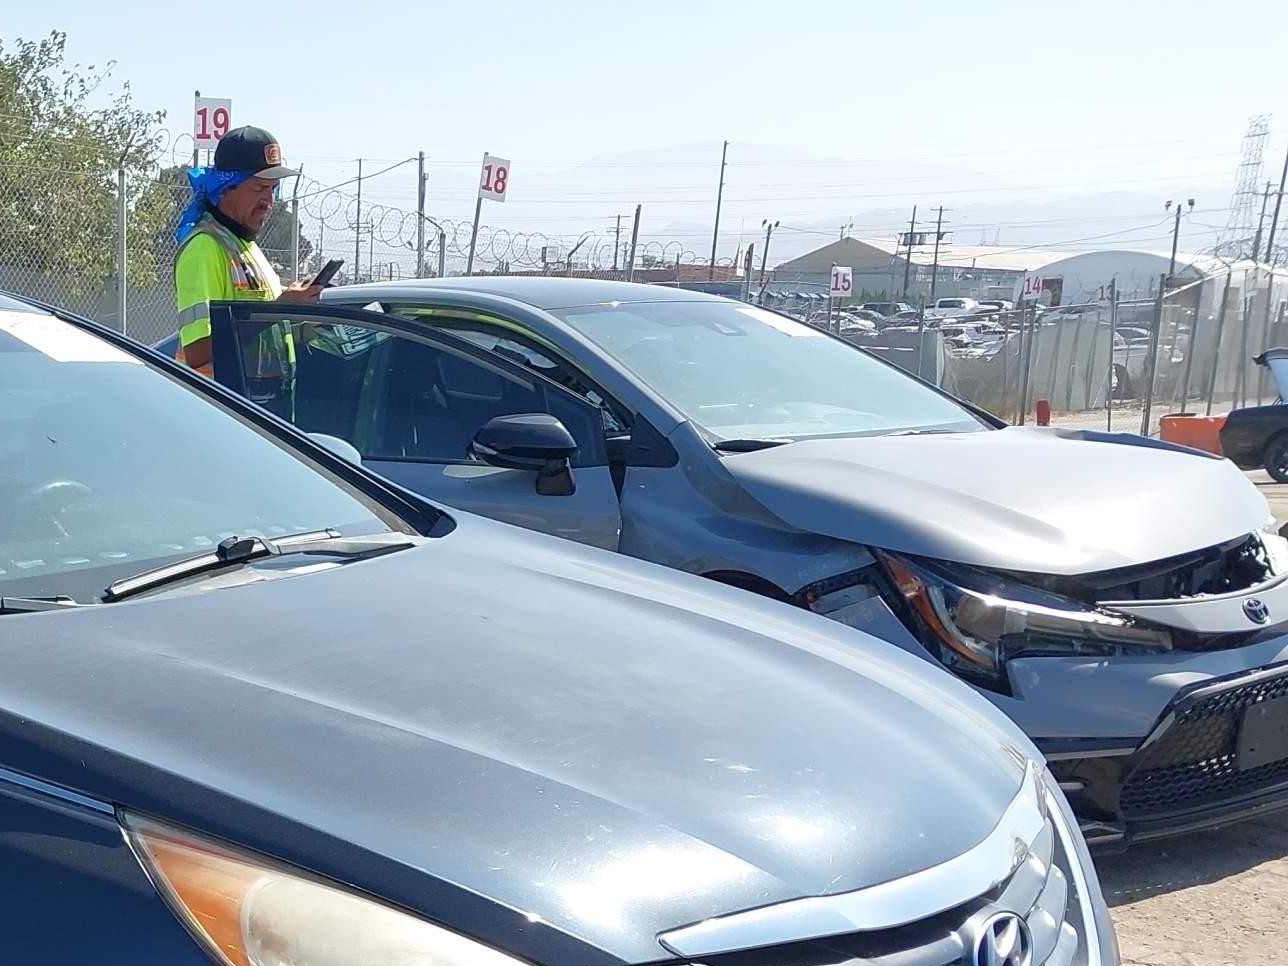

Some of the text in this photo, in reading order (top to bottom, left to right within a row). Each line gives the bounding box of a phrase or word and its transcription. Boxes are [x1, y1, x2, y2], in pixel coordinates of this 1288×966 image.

[196, 107, 229, 140] 19
[481, 164, 507, 194] 18
[831, 272, 851, 292] 15
[1024, 276, 1041, 295] 14
[1098, 285, 1112, 301] 13
